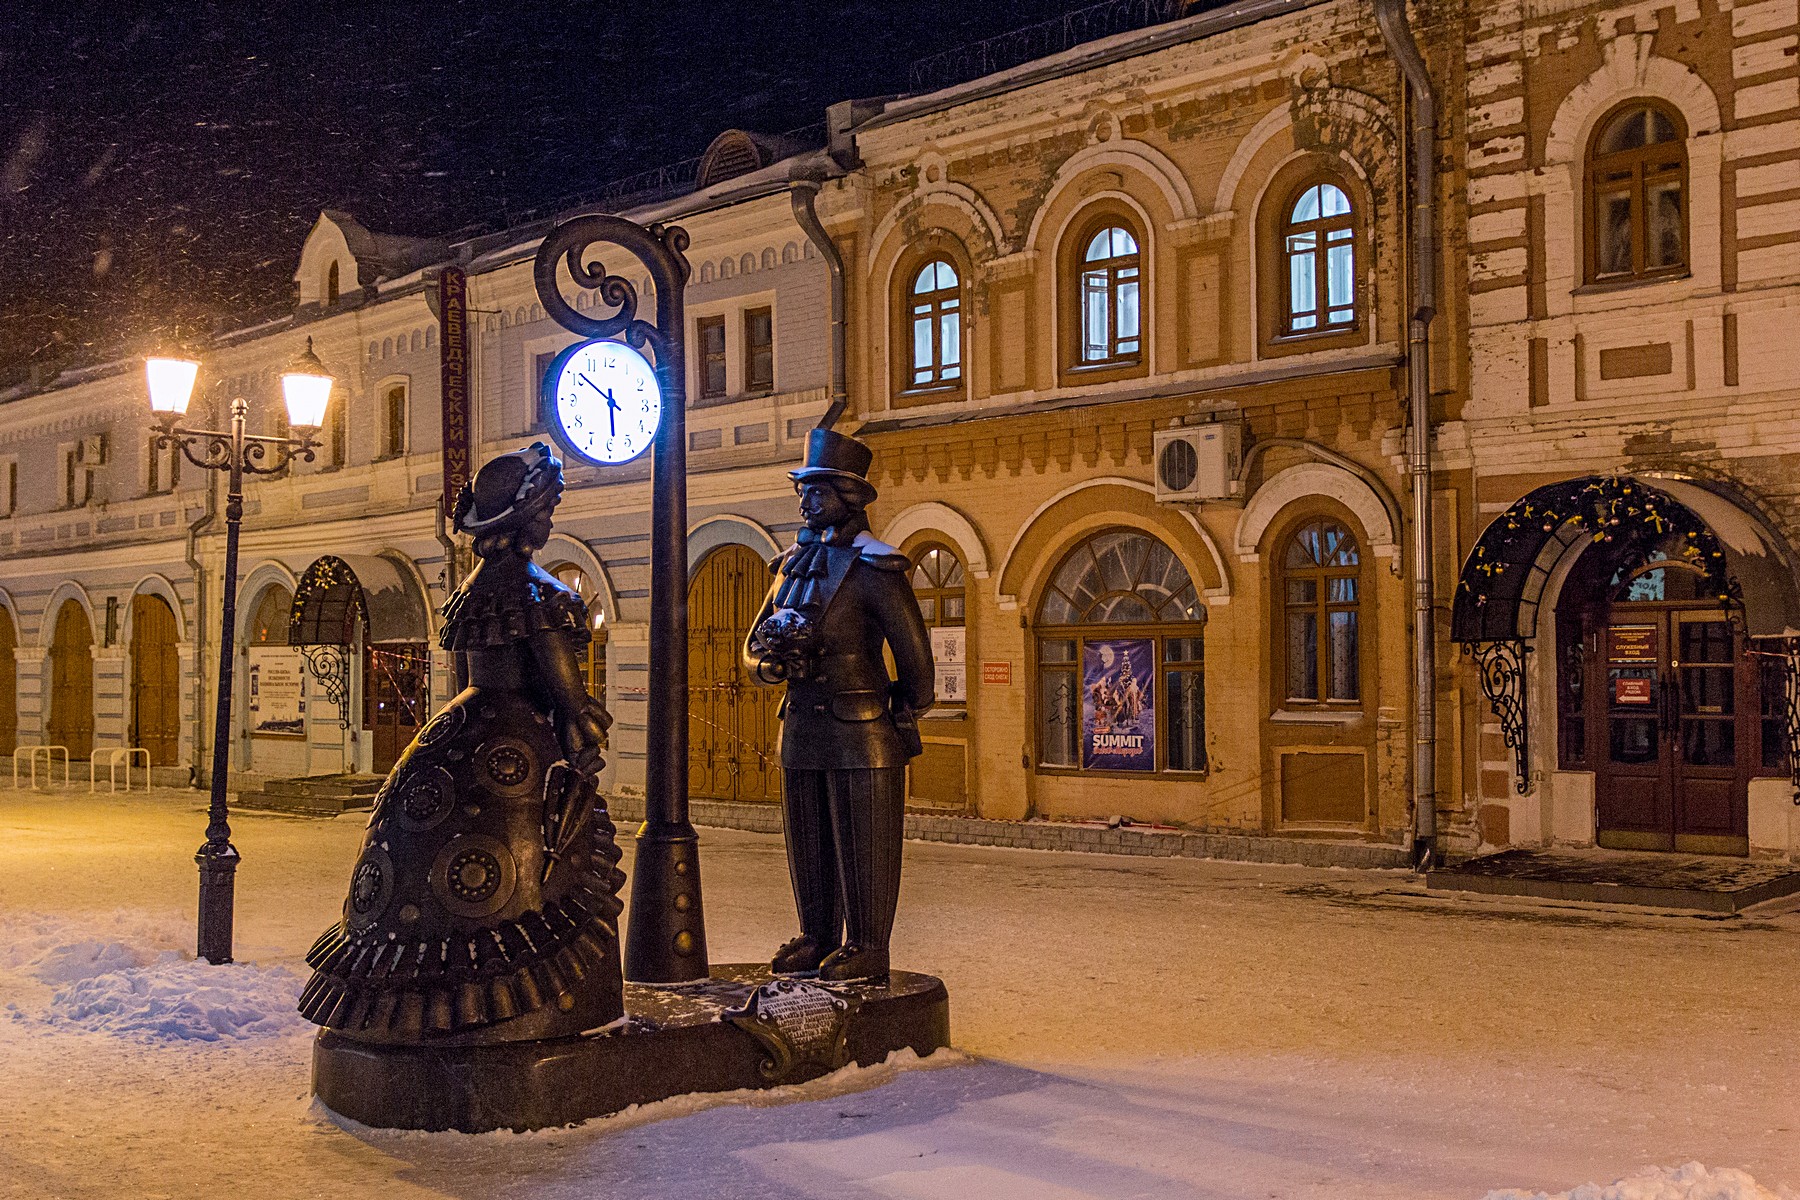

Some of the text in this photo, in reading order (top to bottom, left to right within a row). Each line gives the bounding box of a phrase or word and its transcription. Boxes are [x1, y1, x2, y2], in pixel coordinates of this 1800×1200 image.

[446, 272, 464, 441] КРАЕВЕДЧЕСКИЙ
[604, 357, 616, 369] 12
[587, 358, 596, 372] 11
[572, 373, 585, 387] 10
[636, 378, 645, 392] 2
[569, 393, 578, 407] 9
[641, 399, 650, 413] 3
[574, 414, 583, 428] 8
[638, 419, 645, 433] 4
[588, 431, 595, 445] 7
[606, 438, 614, 452] 6
[624, 434, 632, 448] 5
[1093, 735, 1144, 747] SUMMIT
